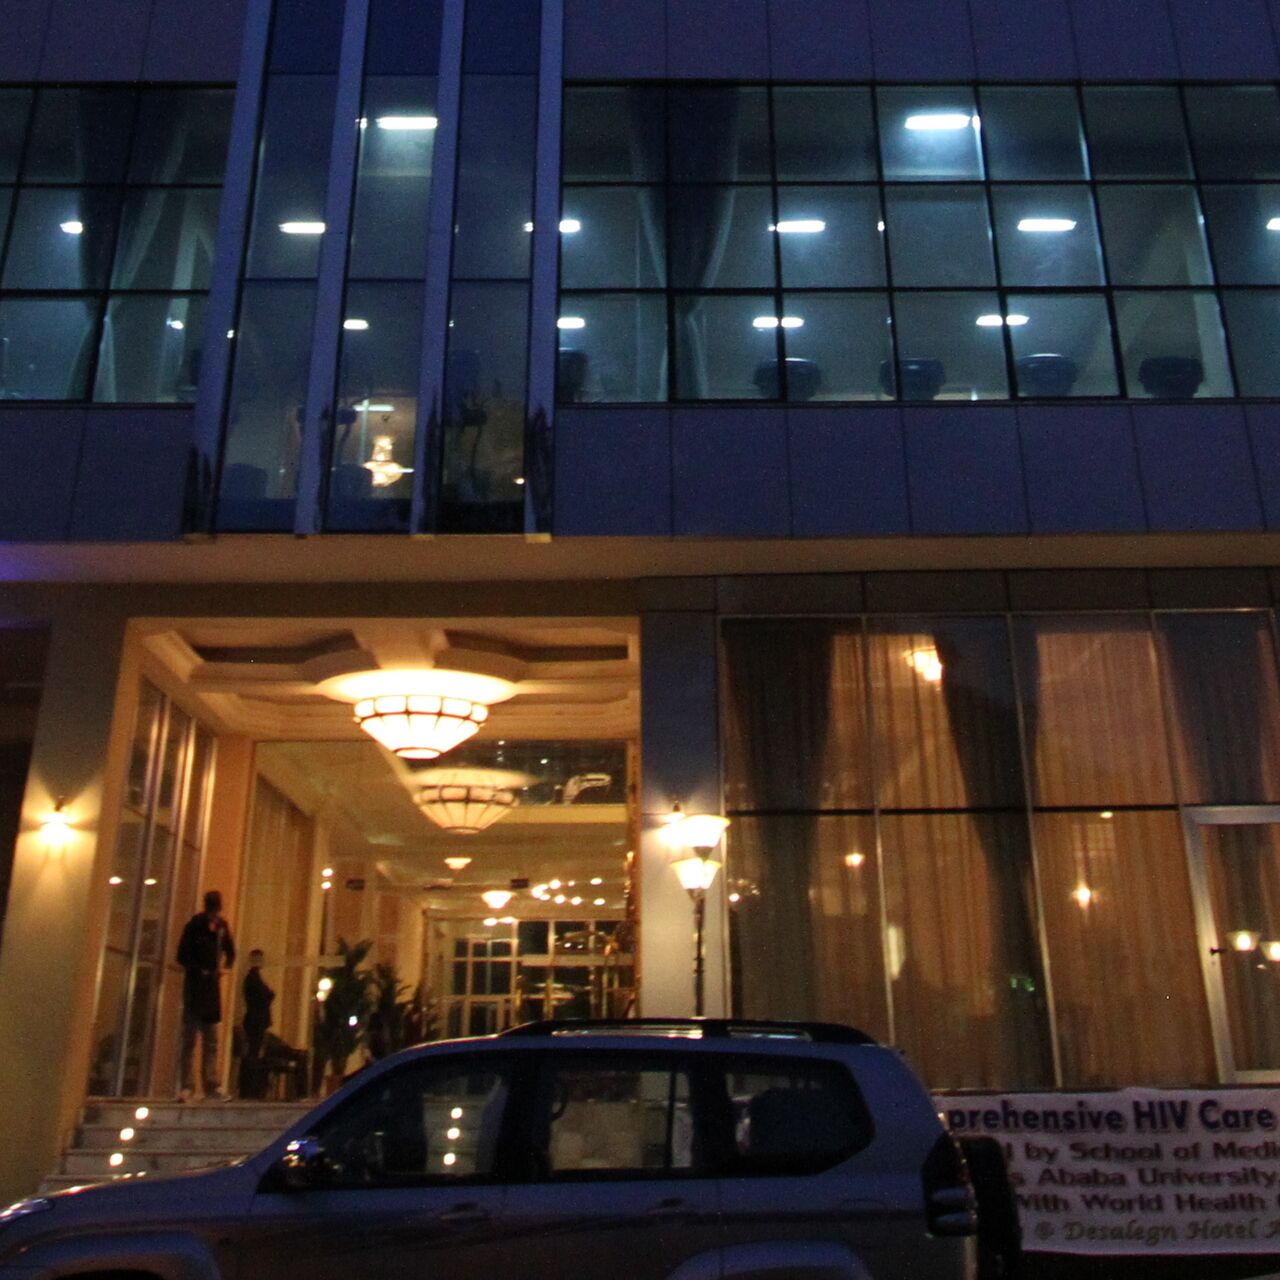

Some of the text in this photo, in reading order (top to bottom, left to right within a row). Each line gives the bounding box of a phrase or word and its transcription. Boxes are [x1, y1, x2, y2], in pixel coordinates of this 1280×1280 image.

[948, 1099, 1124, 1131] prehensive
[1131, 1099, 1189, 1130] HIV
[1198, 1098, 1275, 1130] Care
[1024, 1141, 1059, 1163] by
[1069, 1141, 1162, 1161] School
[1173, 1141, 1201, 1160] of
[1037, 1167, 1127, 1186] Ababa
[1081, 1192, 1163, 1213] World
[1174, 1191, 1266, 1212] Health
[1063, 1219, 1177, 1247] Desalegn
[1186, 1217, 1258, 1241] Hotel
